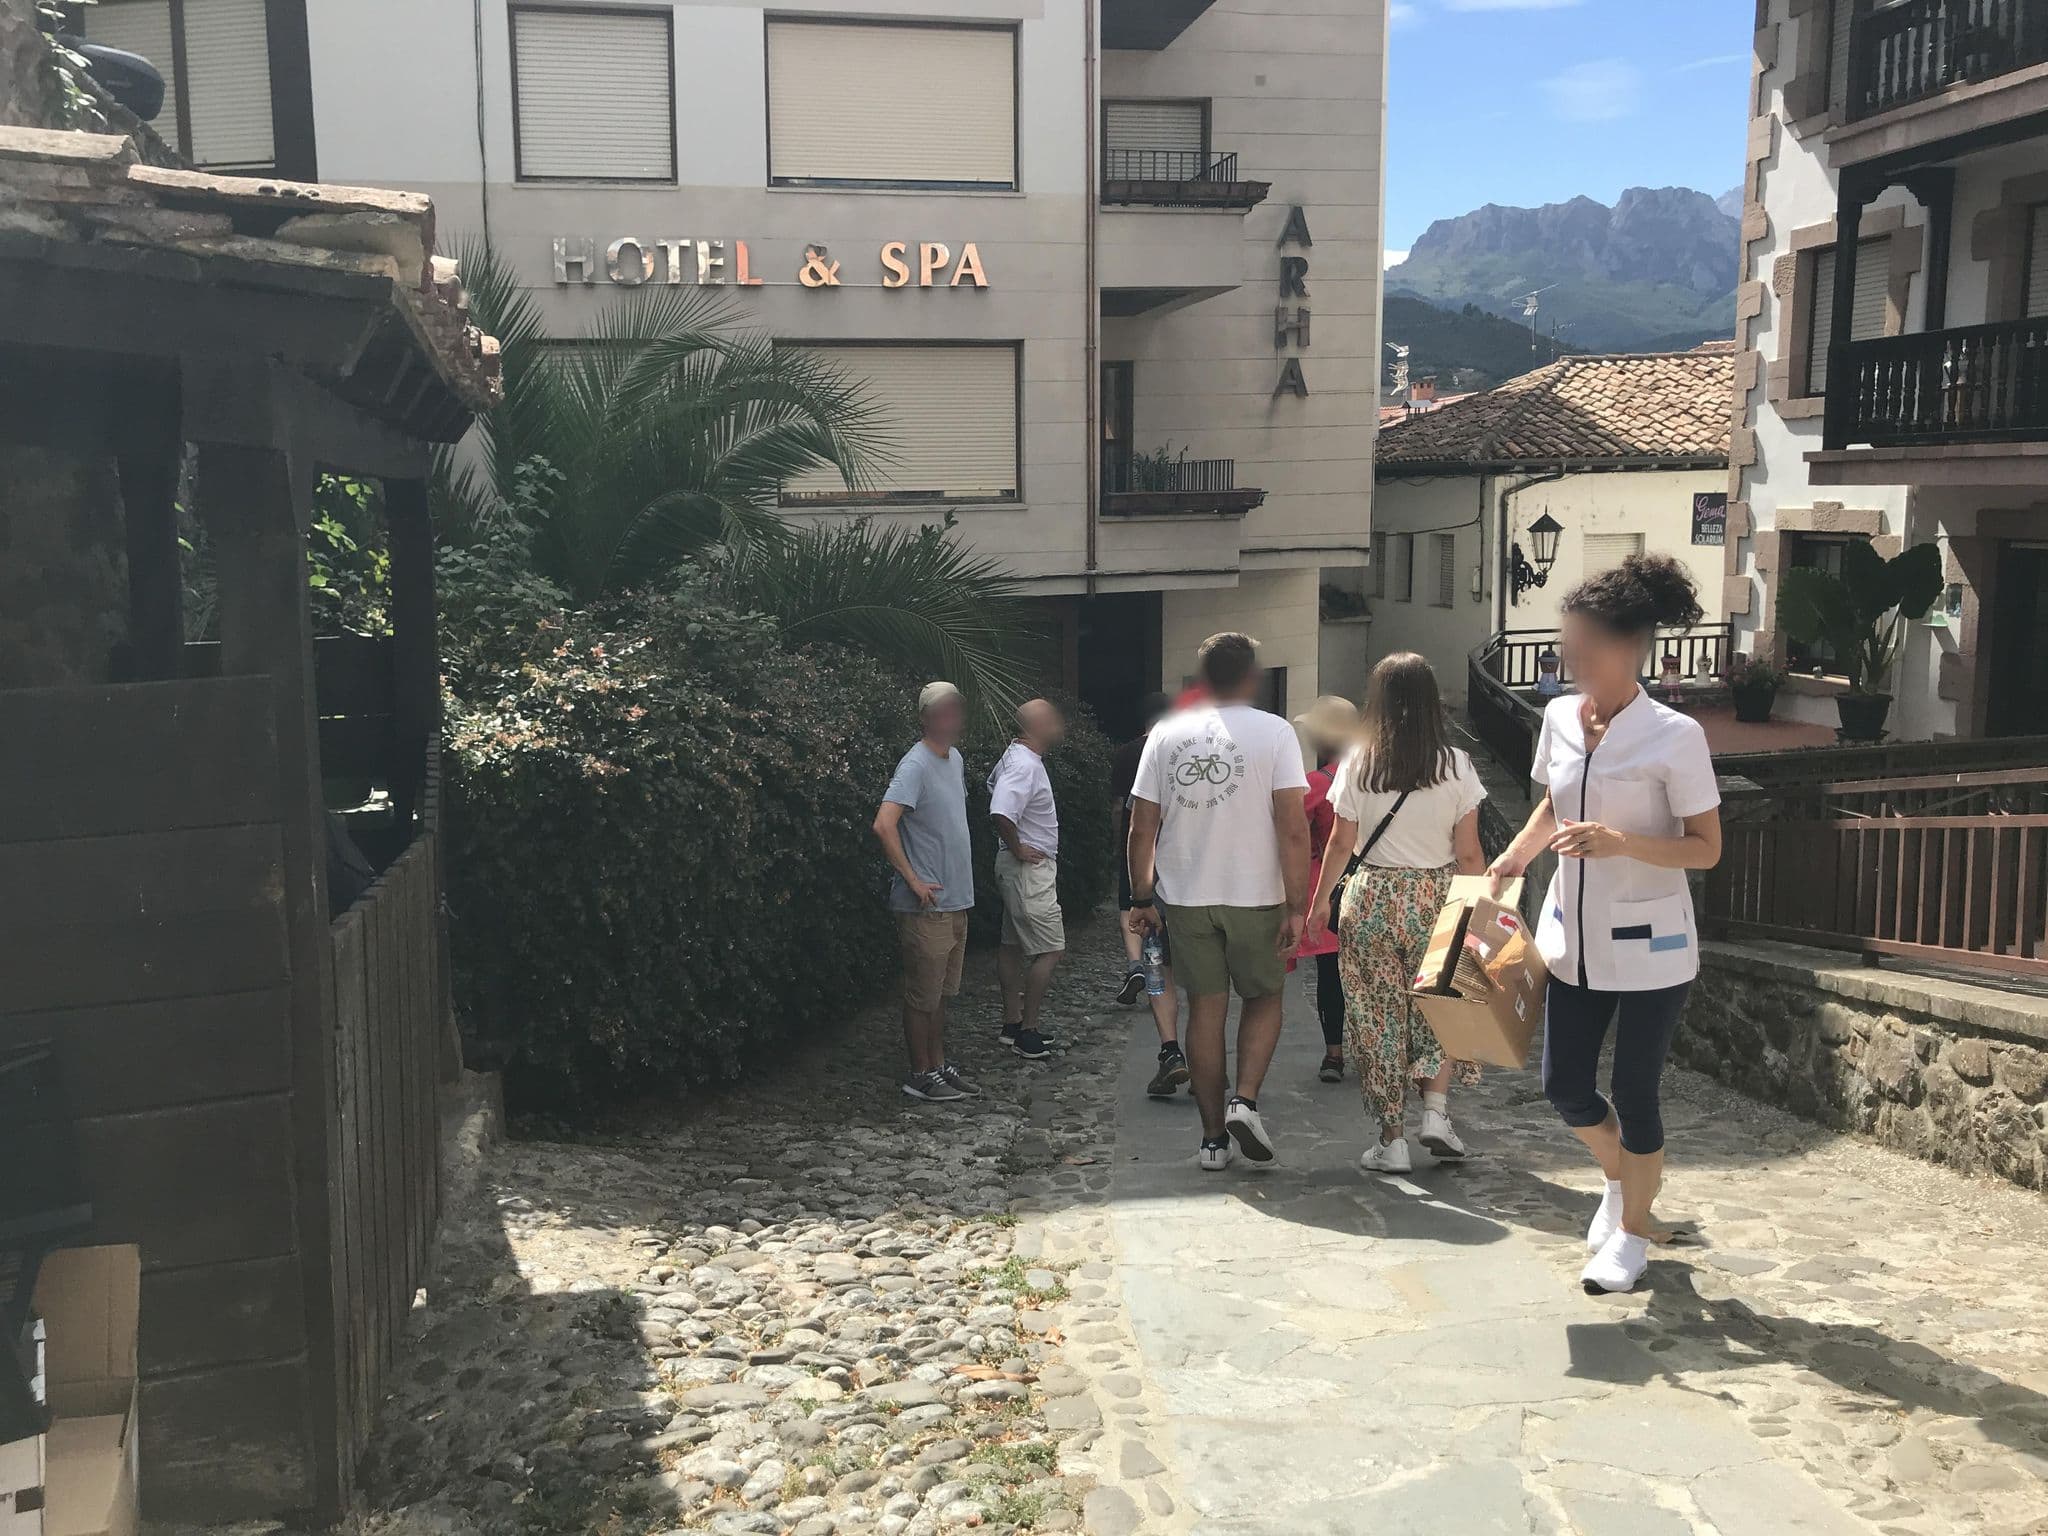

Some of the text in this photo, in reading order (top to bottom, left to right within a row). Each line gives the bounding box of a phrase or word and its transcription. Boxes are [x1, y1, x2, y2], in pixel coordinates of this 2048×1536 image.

[552, 237, 990, 288] HOTEL & SPA
[1273, 206, 1312, 398] ARHA
[1694, 533, 1724, 545] SOLARIUM
[1701, 523, 1723, 534] BELLEZA
